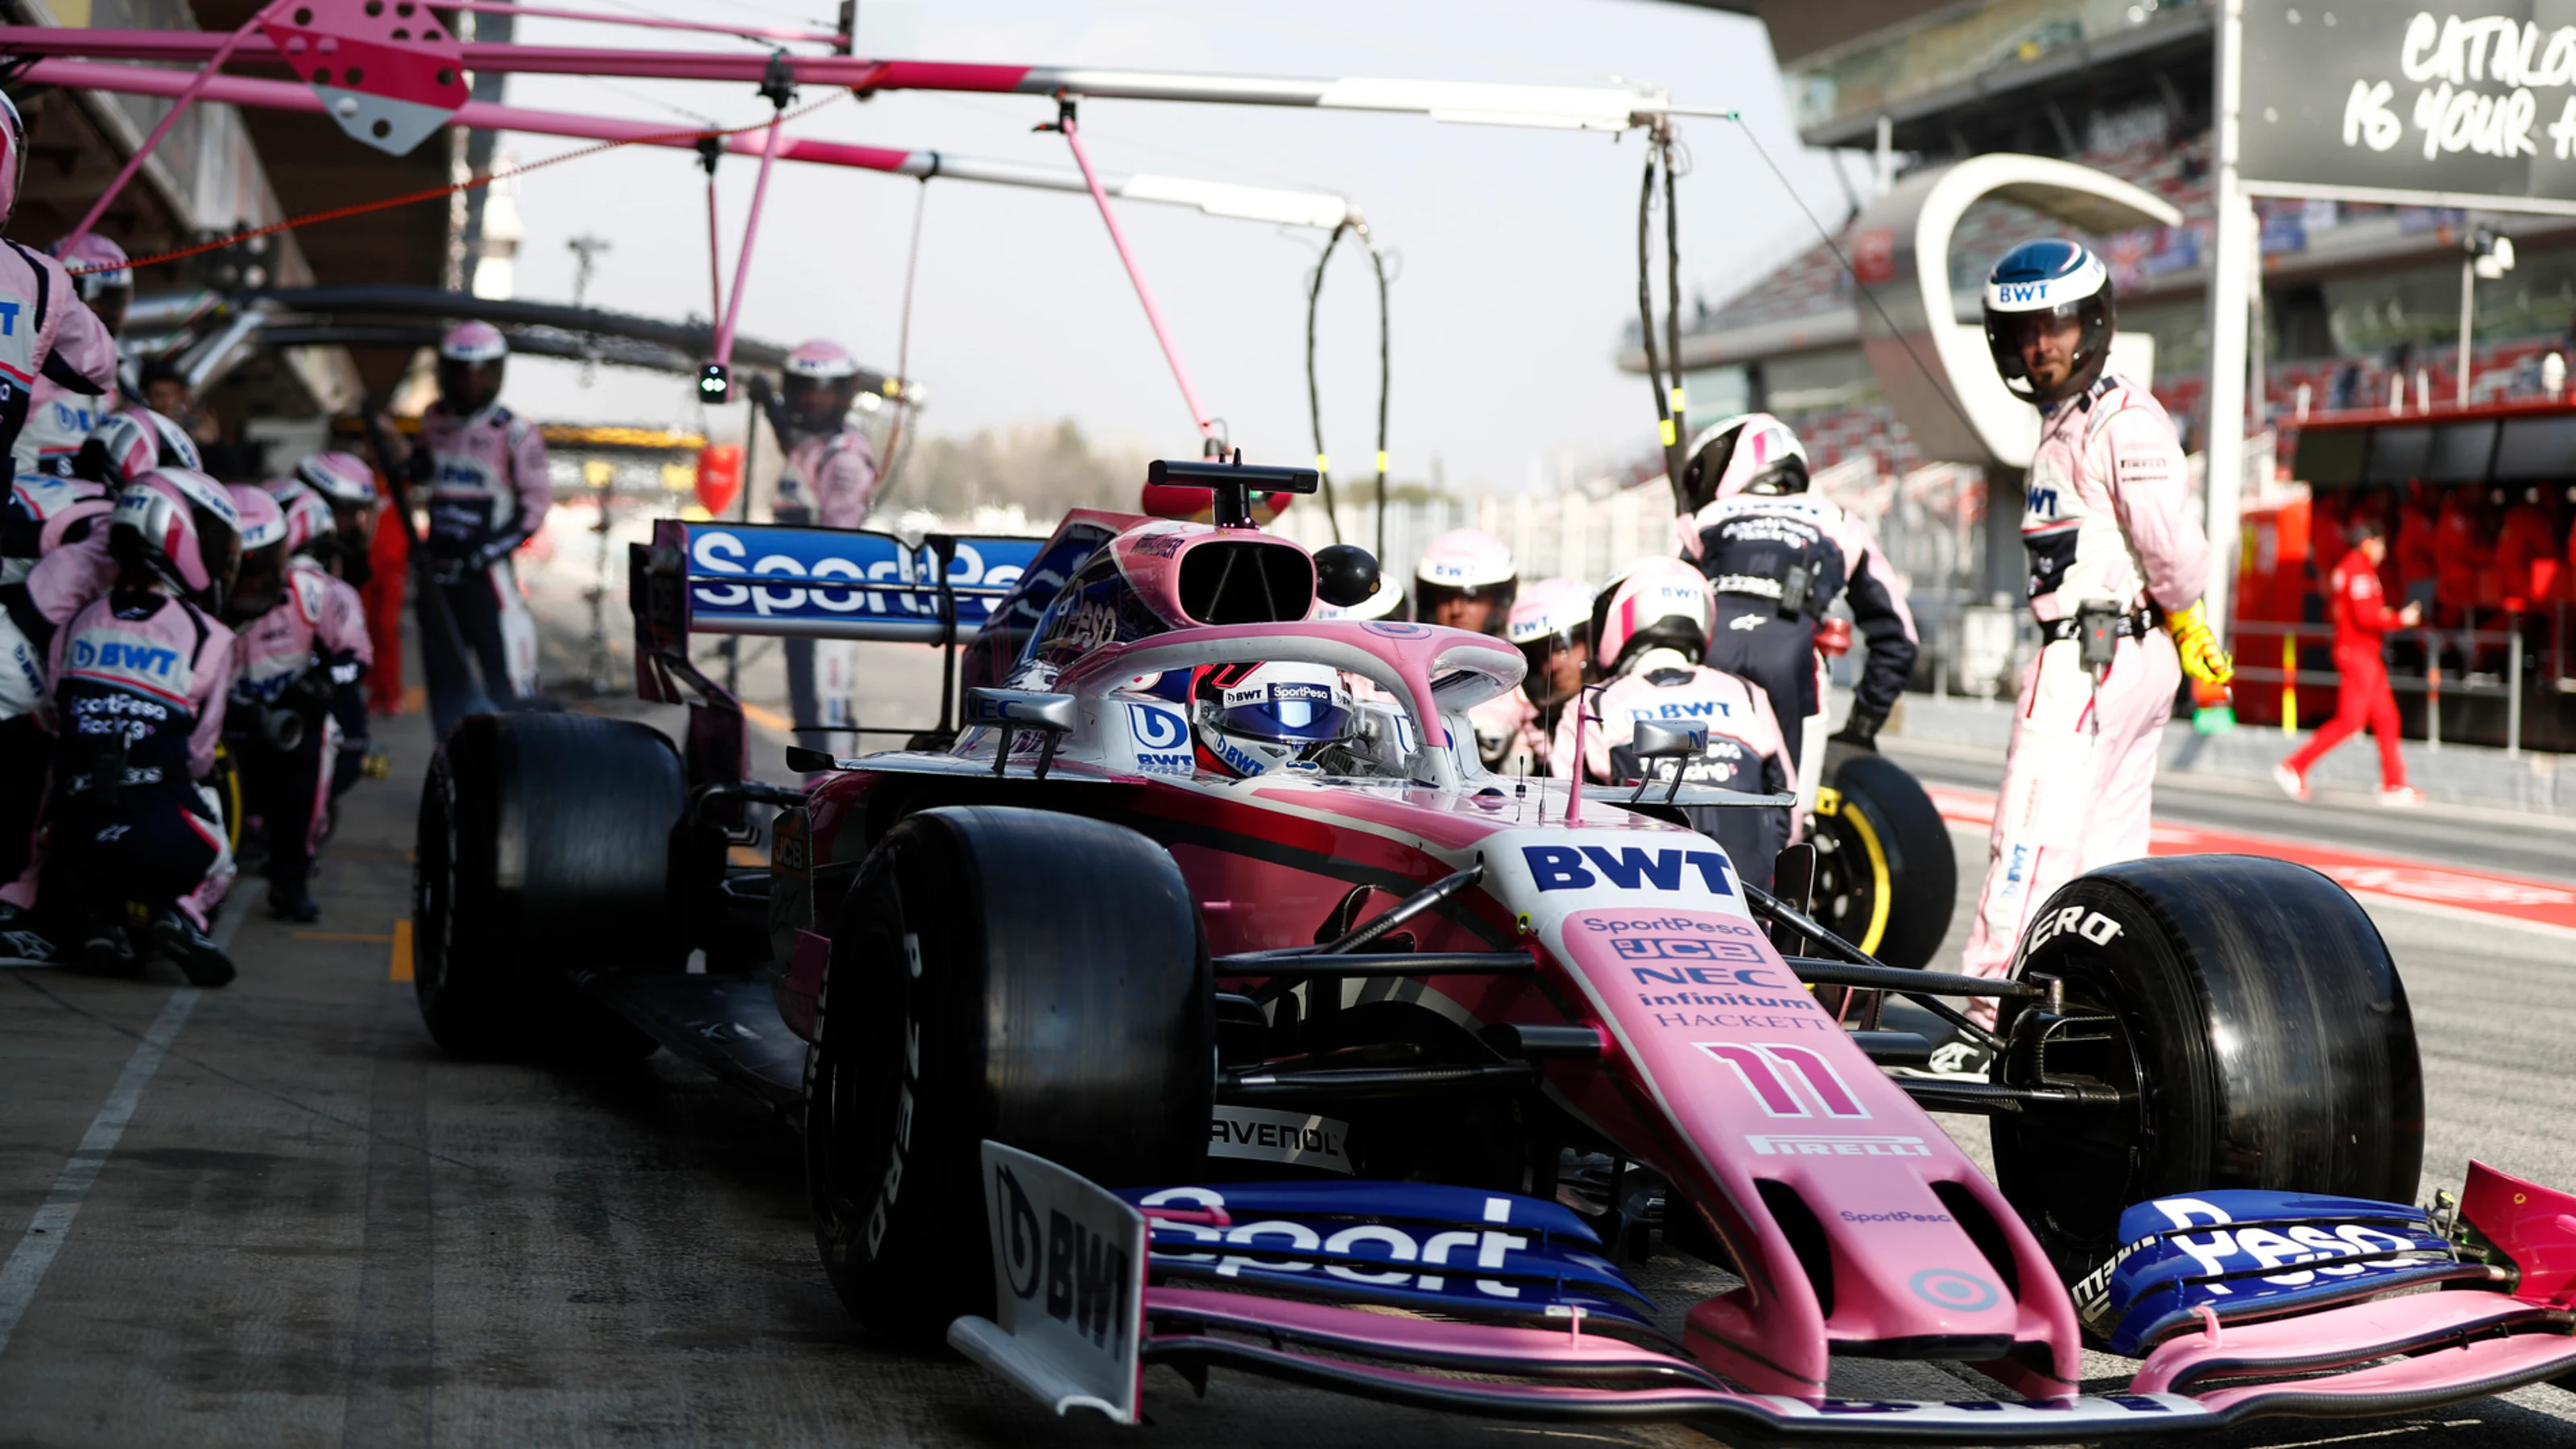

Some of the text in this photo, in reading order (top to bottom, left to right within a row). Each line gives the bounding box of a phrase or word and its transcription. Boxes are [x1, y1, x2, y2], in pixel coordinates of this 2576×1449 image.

[2402, 11, 2576, 87] CATALO
[2414, 80, 2537, 160] YOUR
[2000, 284, 2049, 303] BWT
[2028, 487, 2057, 517] WT
[693, 532, 1027, 616] SportPe
[101, 642, 178, 676] BWT
[1236, 690, 1262, 702] BWT
[1274, 687, 1328, 699] SportPesa
[968, 698, 1023, 720] NEC
[1660, 701, 1730, 719] BWT
[1688, 729, 1708, 749] NE
[1224, 745, 1264, 776] BWT
[775, 836, 802, 870] JCB
[2007, 844, 2028, 882] BWT
[1521, 845, 1735, 896] BWT
[1583, 918, 1755, 937] SportPesa
[1610, 938, 1767, 964] JCB
[1631, 968, 1788, 989] NEC
[1638, 993, 1815, 1011] infinitum
[1654, 1012, 1826, 1030] HACKETT
[1691, 1042, 1874, 1119] 11
[1210, 1119, 1339, 1157] AVENOL
[1744, 1134, 1932, 1156] PIRELLI
[1839, 1211, 1954, 1224] SportPesa
[1048, 1209, 1128, 1361] BWT
